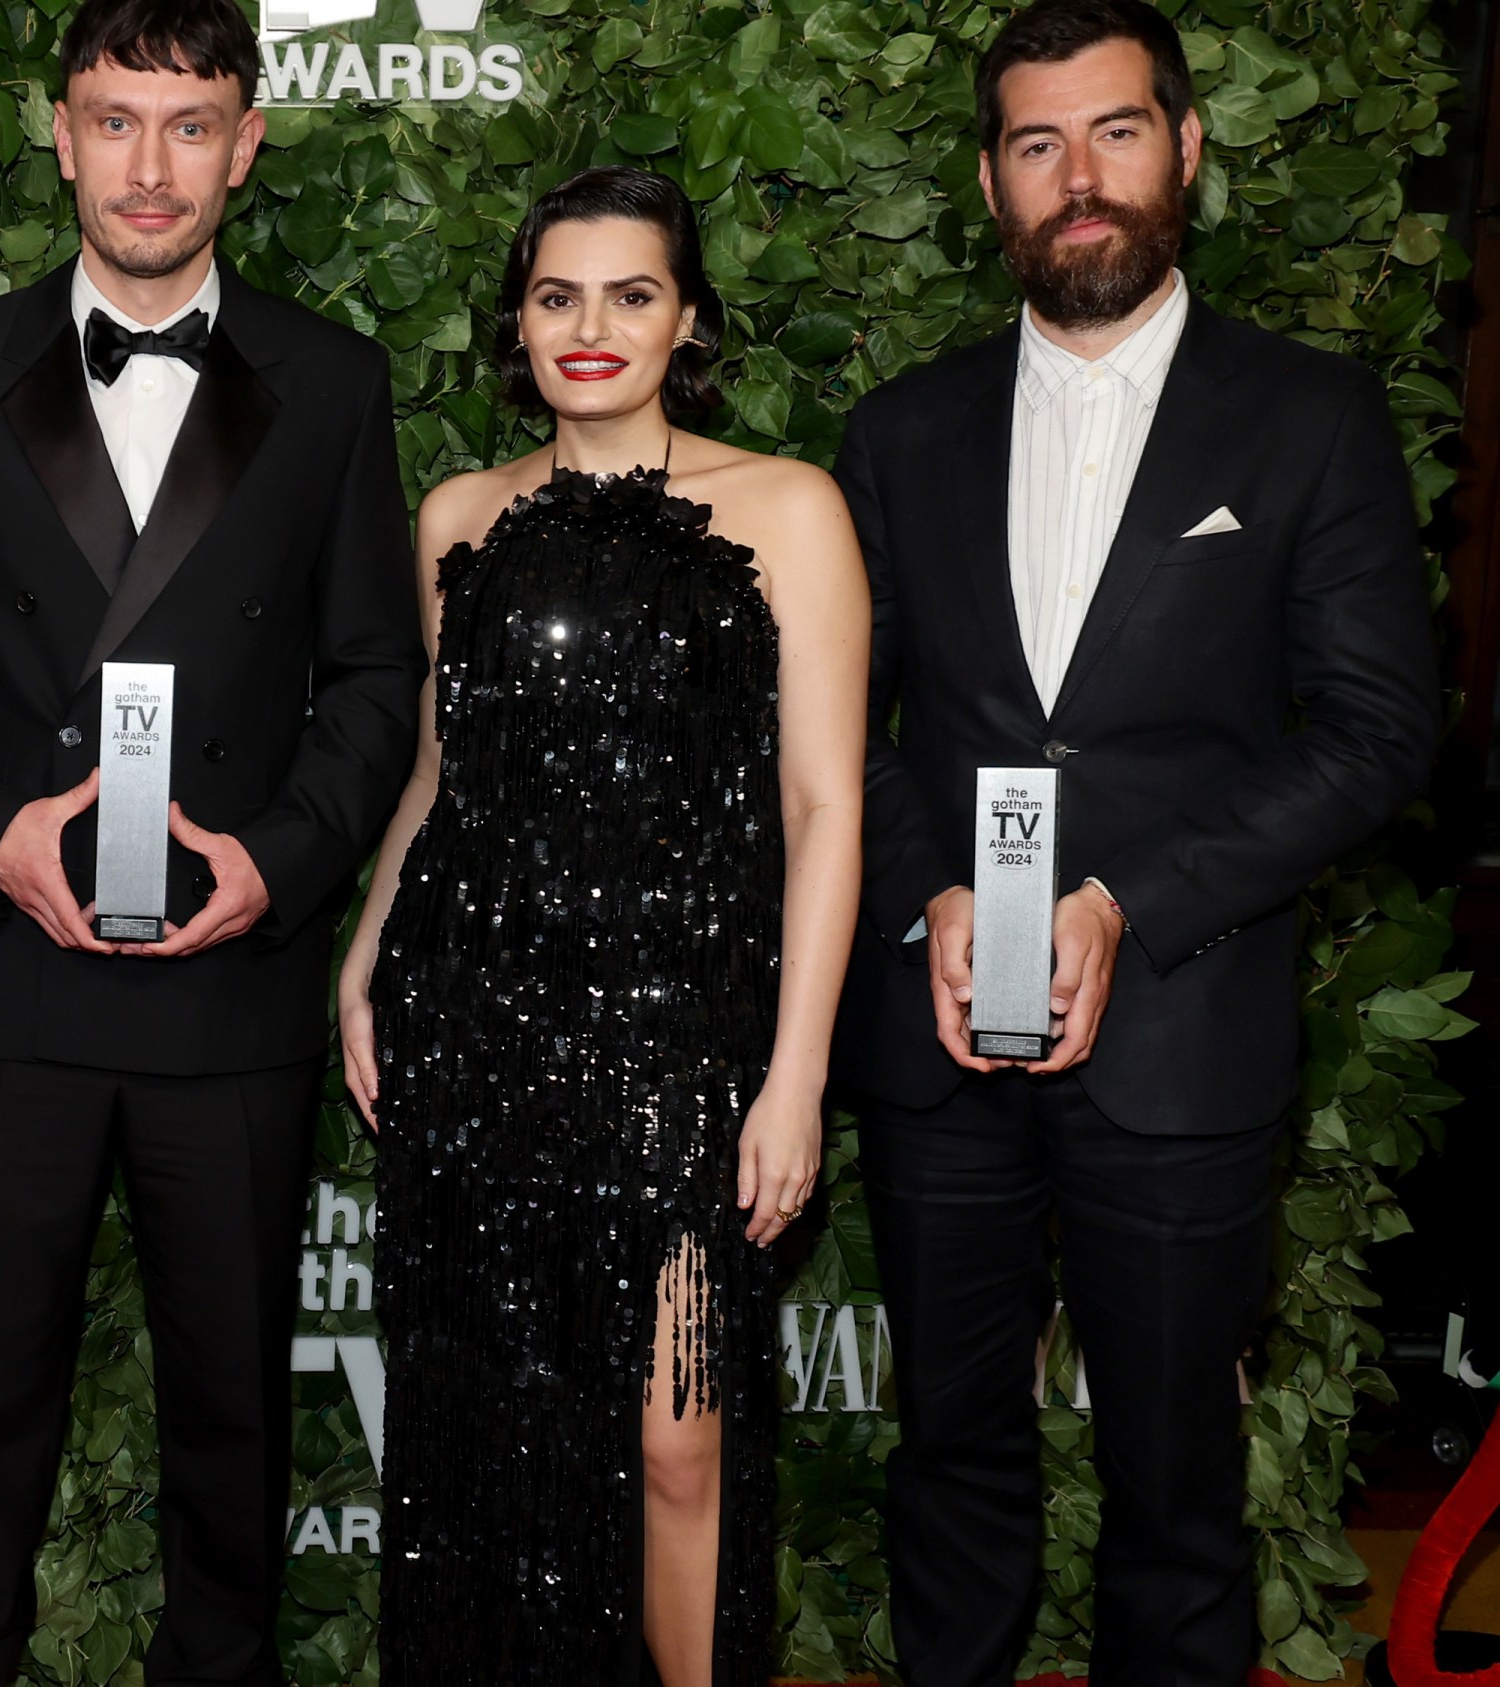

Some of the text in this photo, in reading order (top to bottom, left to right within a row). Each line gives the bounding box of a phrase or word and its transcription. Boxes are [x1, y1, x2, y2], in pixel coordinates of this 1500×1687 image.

[256, 43, 523, 101] WARDS
[128, 682, 148, 692] the
[114, 692, 161, 705] gotham
[115, 704, 158, 732] TV
[112, 731, 160, 742] AWARDS
[119, 744, 151, 756] 2024
[1005, 787, 1028, 798] the
[991, 799, 1042, 811] gotham
[991, 811, 1041, 840] TV
[988, 839, 1042, 850] AWARDS
[996, 853, 1032, 865] 2024
